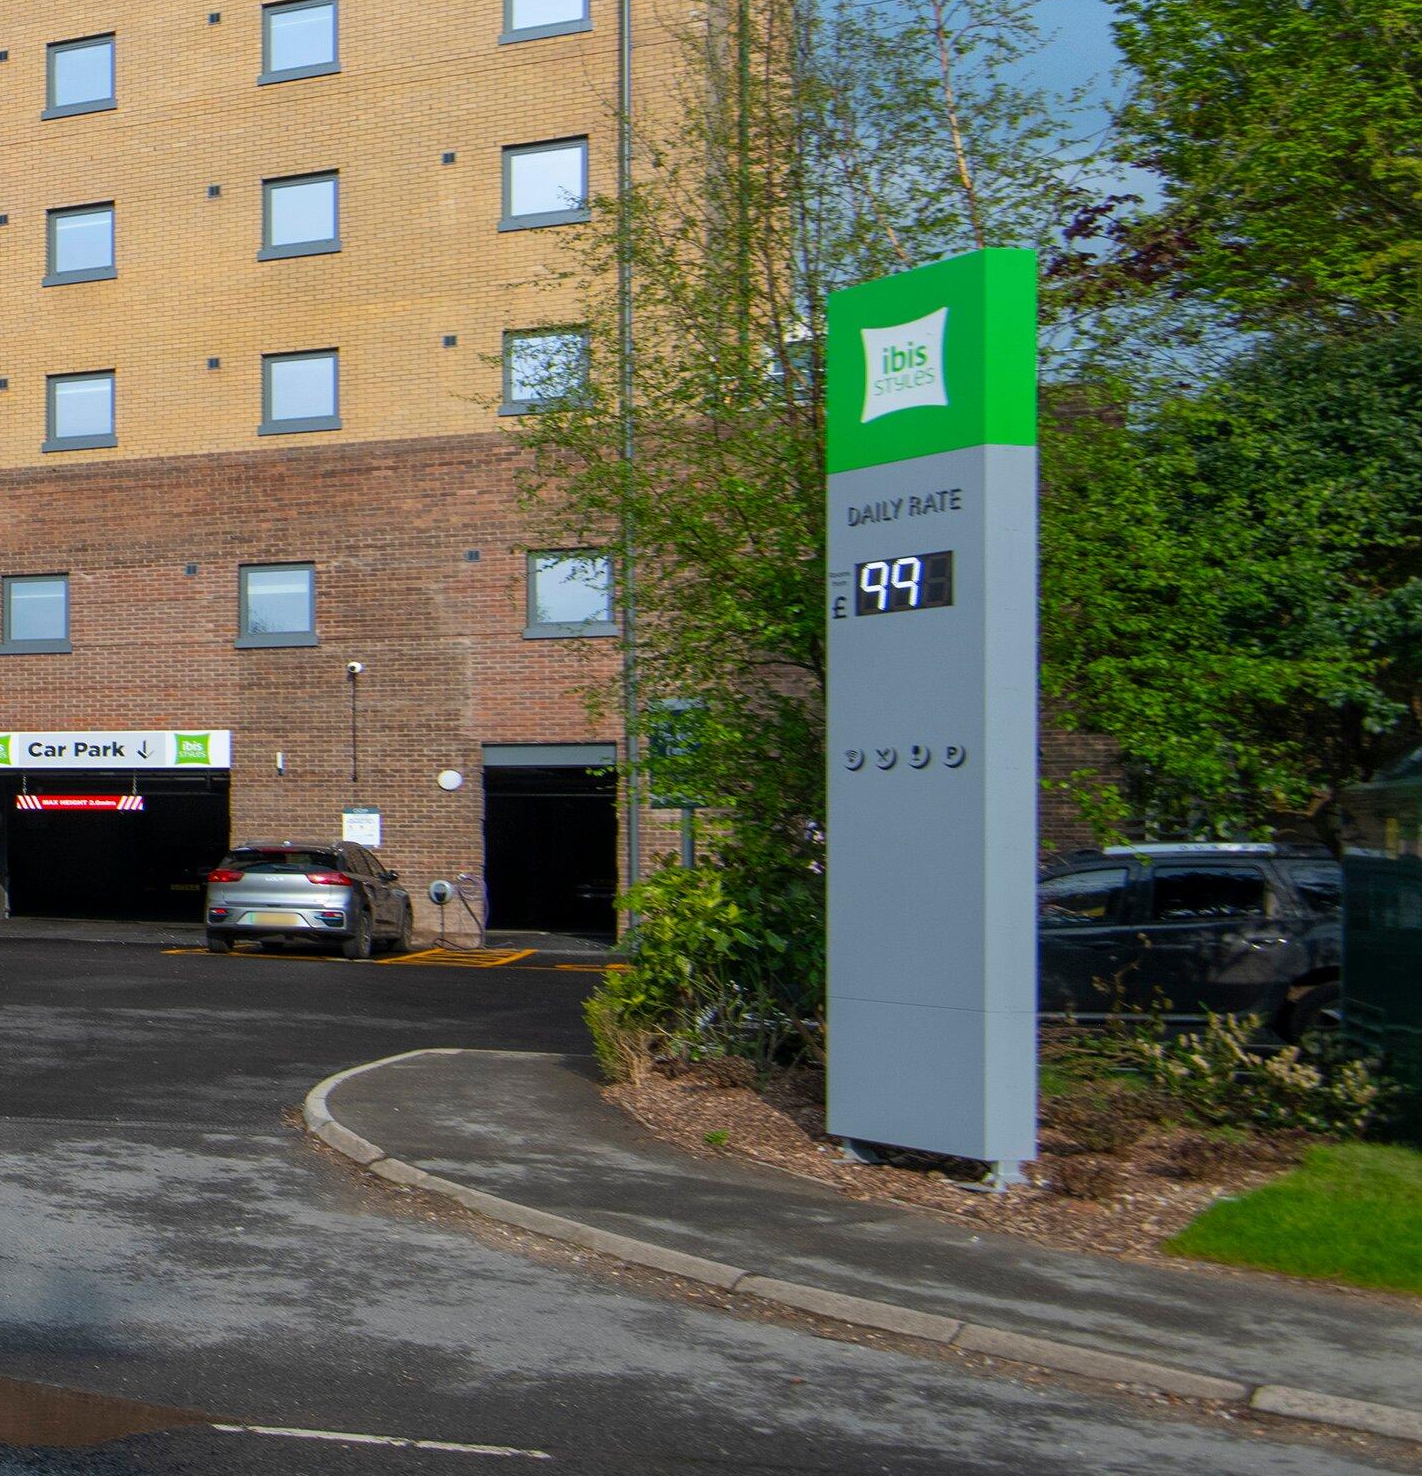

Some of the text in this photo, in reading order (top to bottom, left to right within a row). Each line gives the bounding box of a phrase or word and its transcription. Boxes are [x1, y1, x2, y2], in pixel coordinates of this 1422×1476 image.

[882, 341, 927, 375] ibis
[847, 488, 963, 527] DAILY RATE
[832, 556, 922, 620] £ 99
[28, 741, 125, 758] Car Park
[182, 740, 204, 751] ibis
